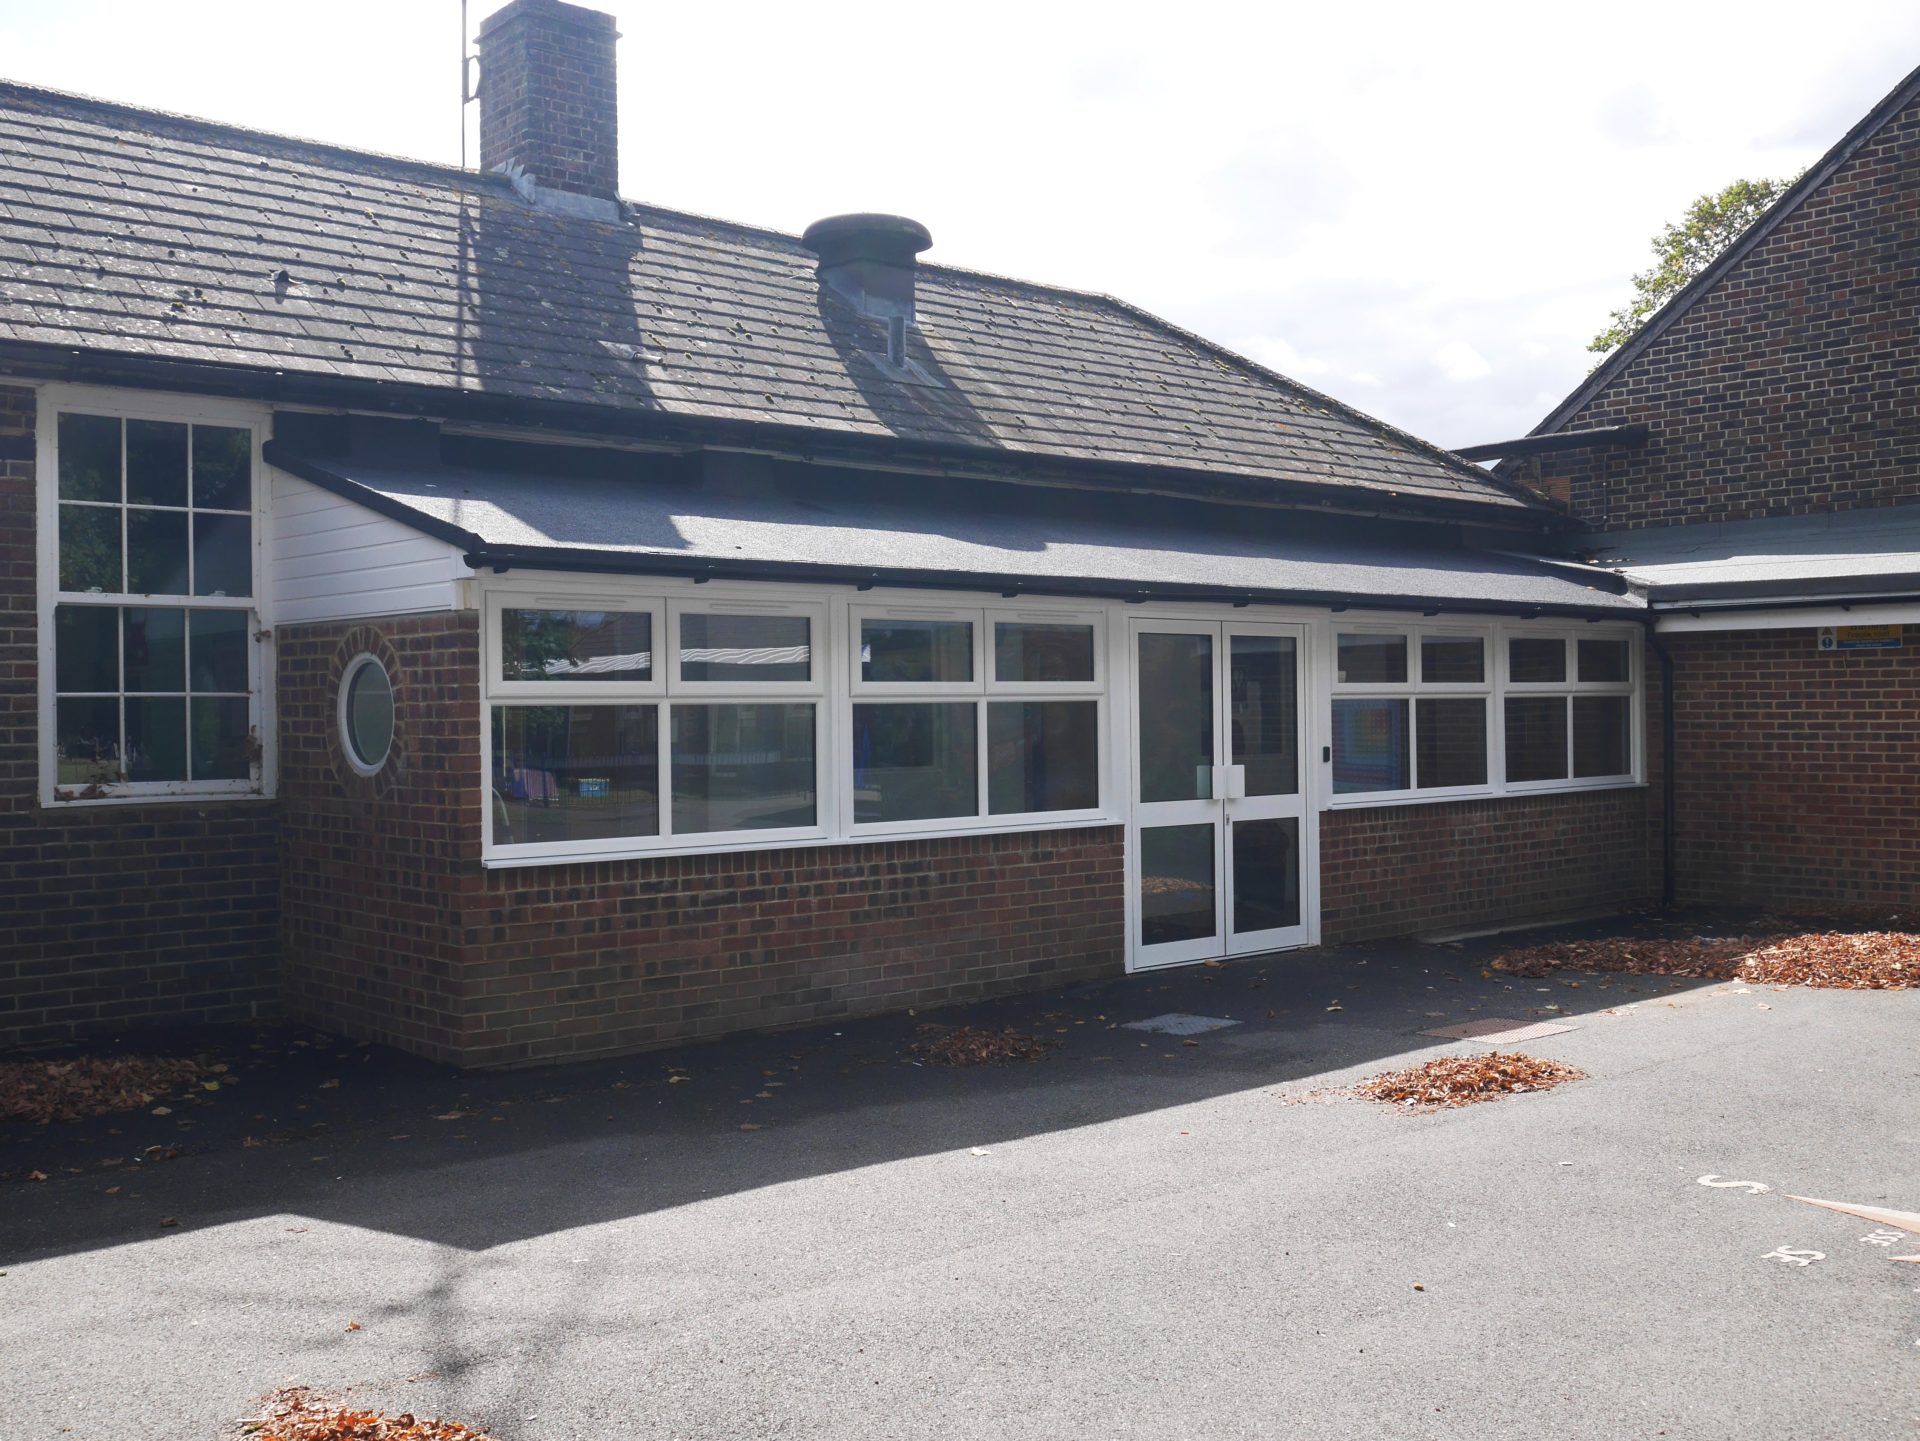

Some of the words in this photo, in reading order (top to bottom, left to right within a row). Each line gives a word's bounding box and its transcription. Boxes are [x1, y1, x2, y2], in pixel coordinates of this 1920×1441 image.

[1697, 1175, 1769, 1195] S
[1859, 1229, 1905, 1246] SSE
[1760, 1245, 1826, 1266] SE
